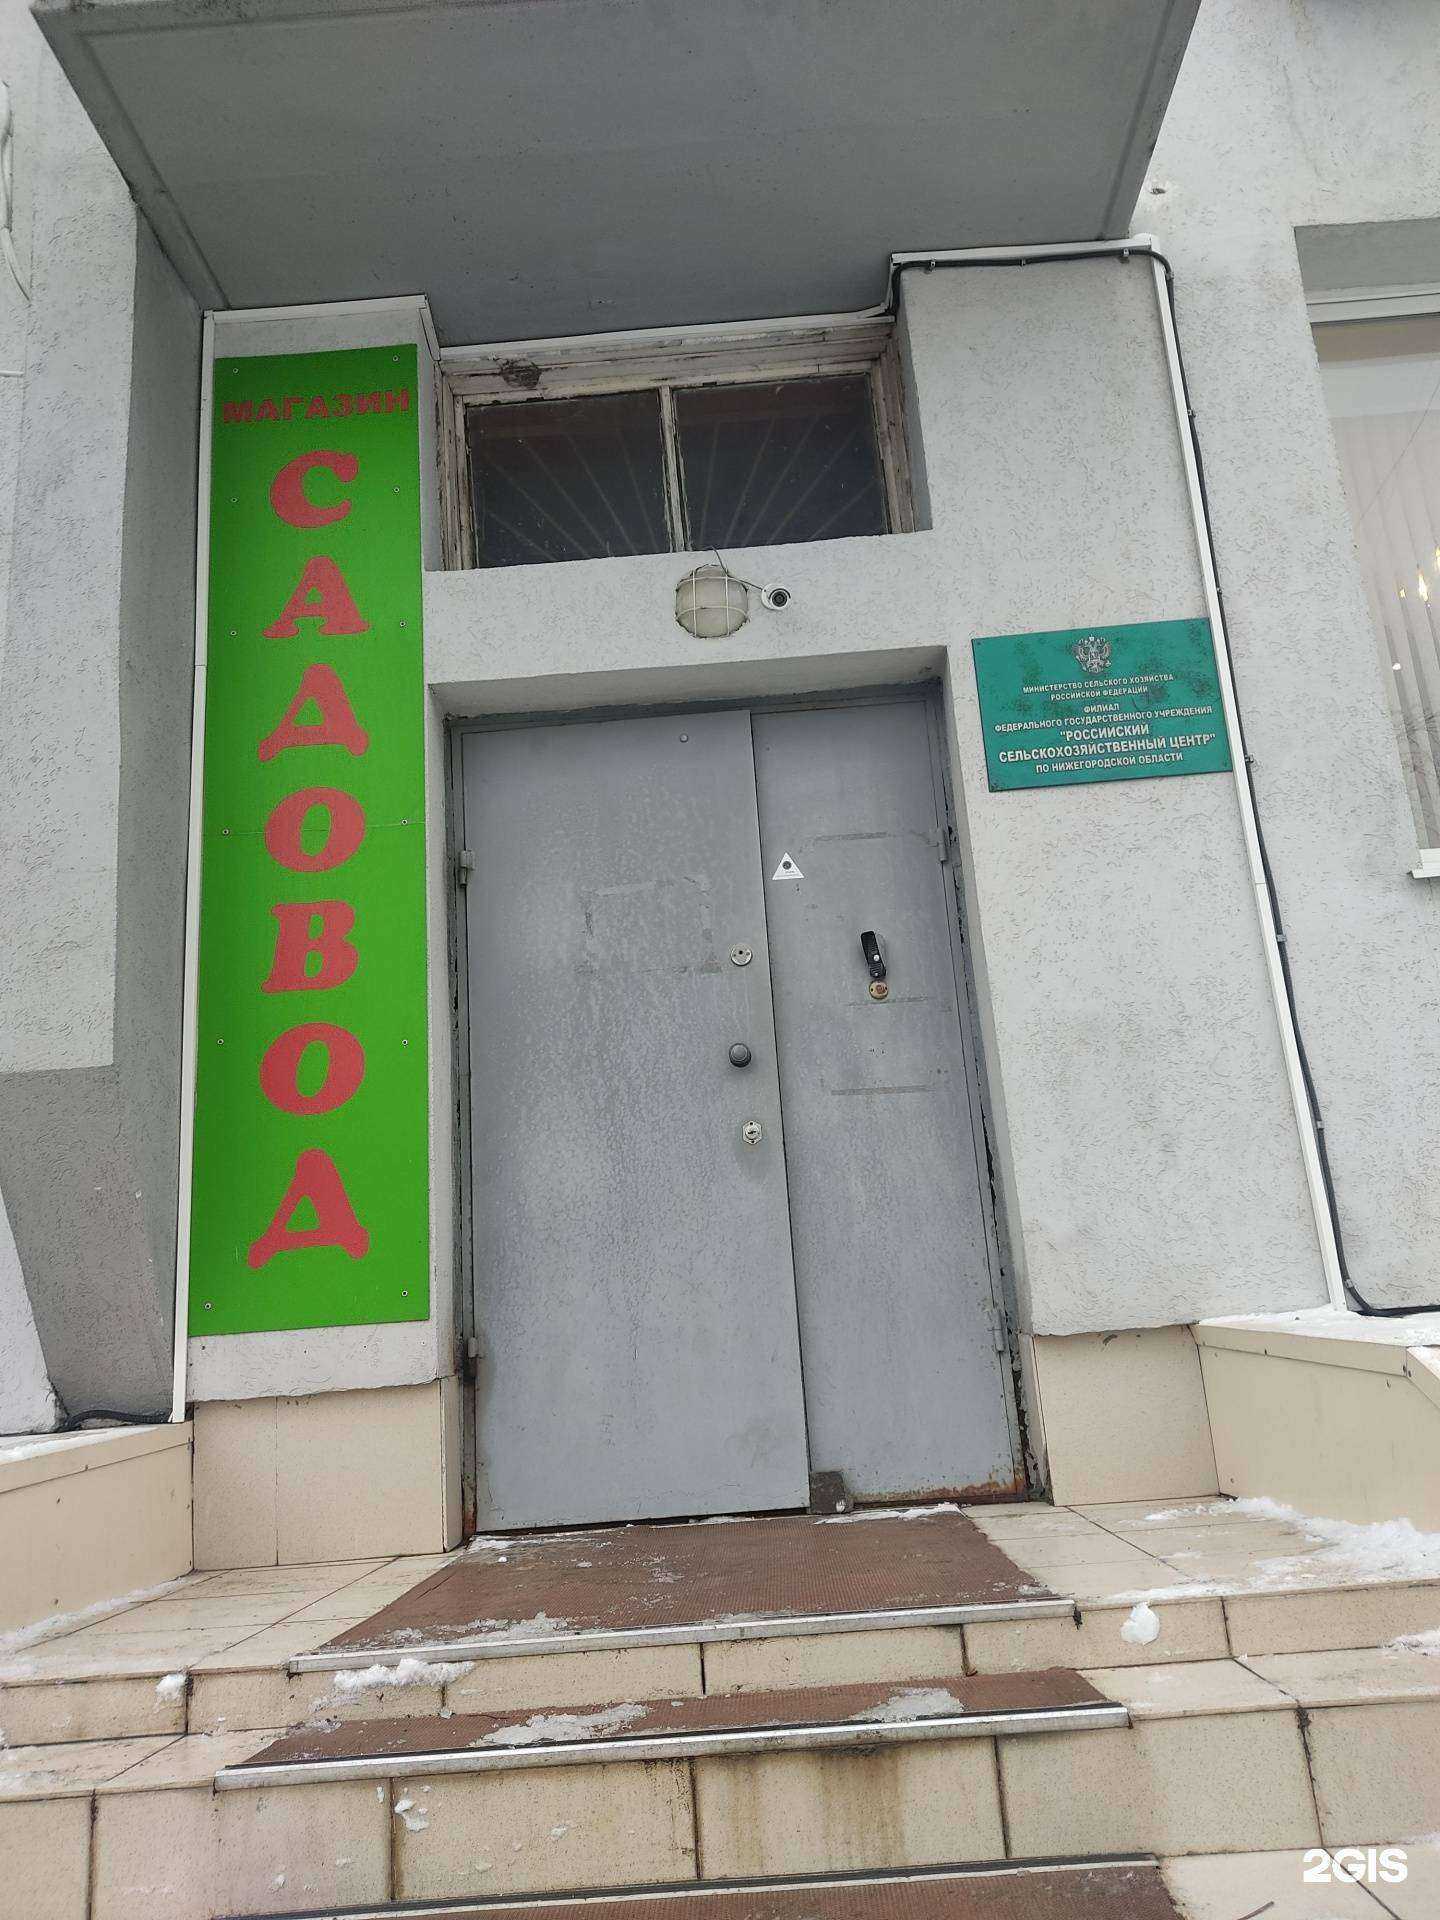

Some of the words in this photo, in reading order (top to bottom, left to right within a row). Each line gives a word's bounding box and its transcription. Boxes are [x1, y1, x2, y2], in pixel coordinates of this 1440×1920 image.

[223, 389, 410, 423] МАГАЗИН
[1023, 682, 1083, 694] МИНИСТЕРСТВО
[1084, 677, 1128, 688] СЕЛЬСКОГО
[1102, 685, 1149, 697] ФЕДЕРАЦИИ
[995, 718, 1063, 732] ФЕДЕРАЛЬНОГО
[1064, 711, 1153, 726] ГОСУДАРСТВЕННОГО
[1154, 705, 1213, 719] УЧРЕЖДЕНИЯ
[1083, 703, 1120, 714] ФИЛИАЛ
[999, 736, 1167, 763] СЕЛЬСКОХОЗЯЙСТВЕННЫЙ
[1169, 733, 1216, 749] ЦЕНТР"
[1036, 764, 1050, 774] ПО
[1051, 755, 1137, 772] НИЖЕГОРОДСКОЙ
[1138, 752, 1184, 765] ОБЛАСТИ
[248, 450, 369, 1269] САДОВОД
